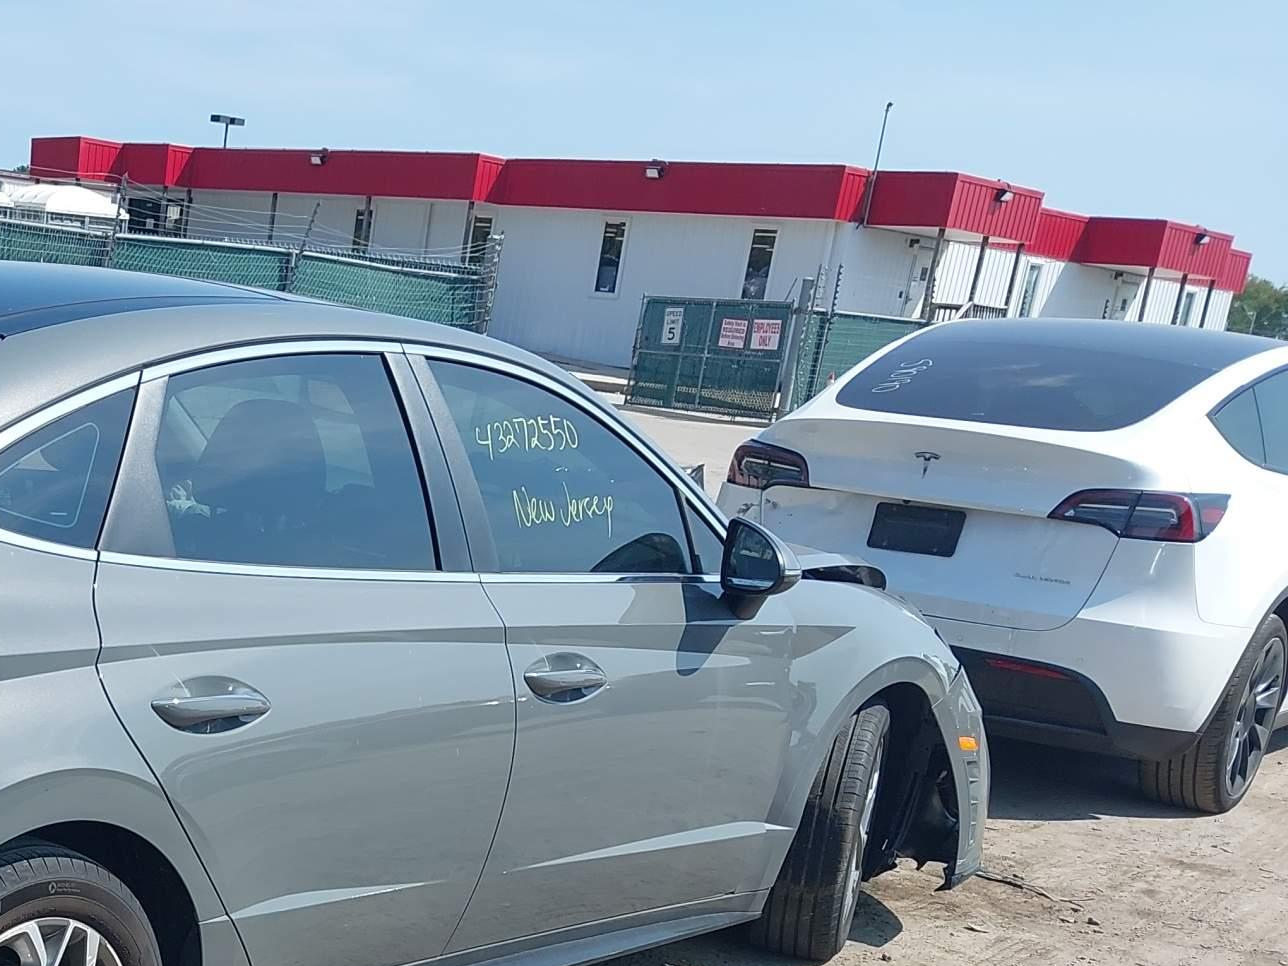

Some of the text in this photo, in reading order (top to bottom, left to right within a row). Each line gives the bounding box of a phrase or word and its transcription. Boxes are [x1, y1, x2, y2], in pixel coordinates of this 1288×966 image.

[667, 326, 676, 341] 5
[753, 322, 781, 334] EMPLOYEES
[758, 335, 772, 347] ONLY
[475, 414, 579, 462] 43272550
[512, 481, 614, 539] New Jersey
